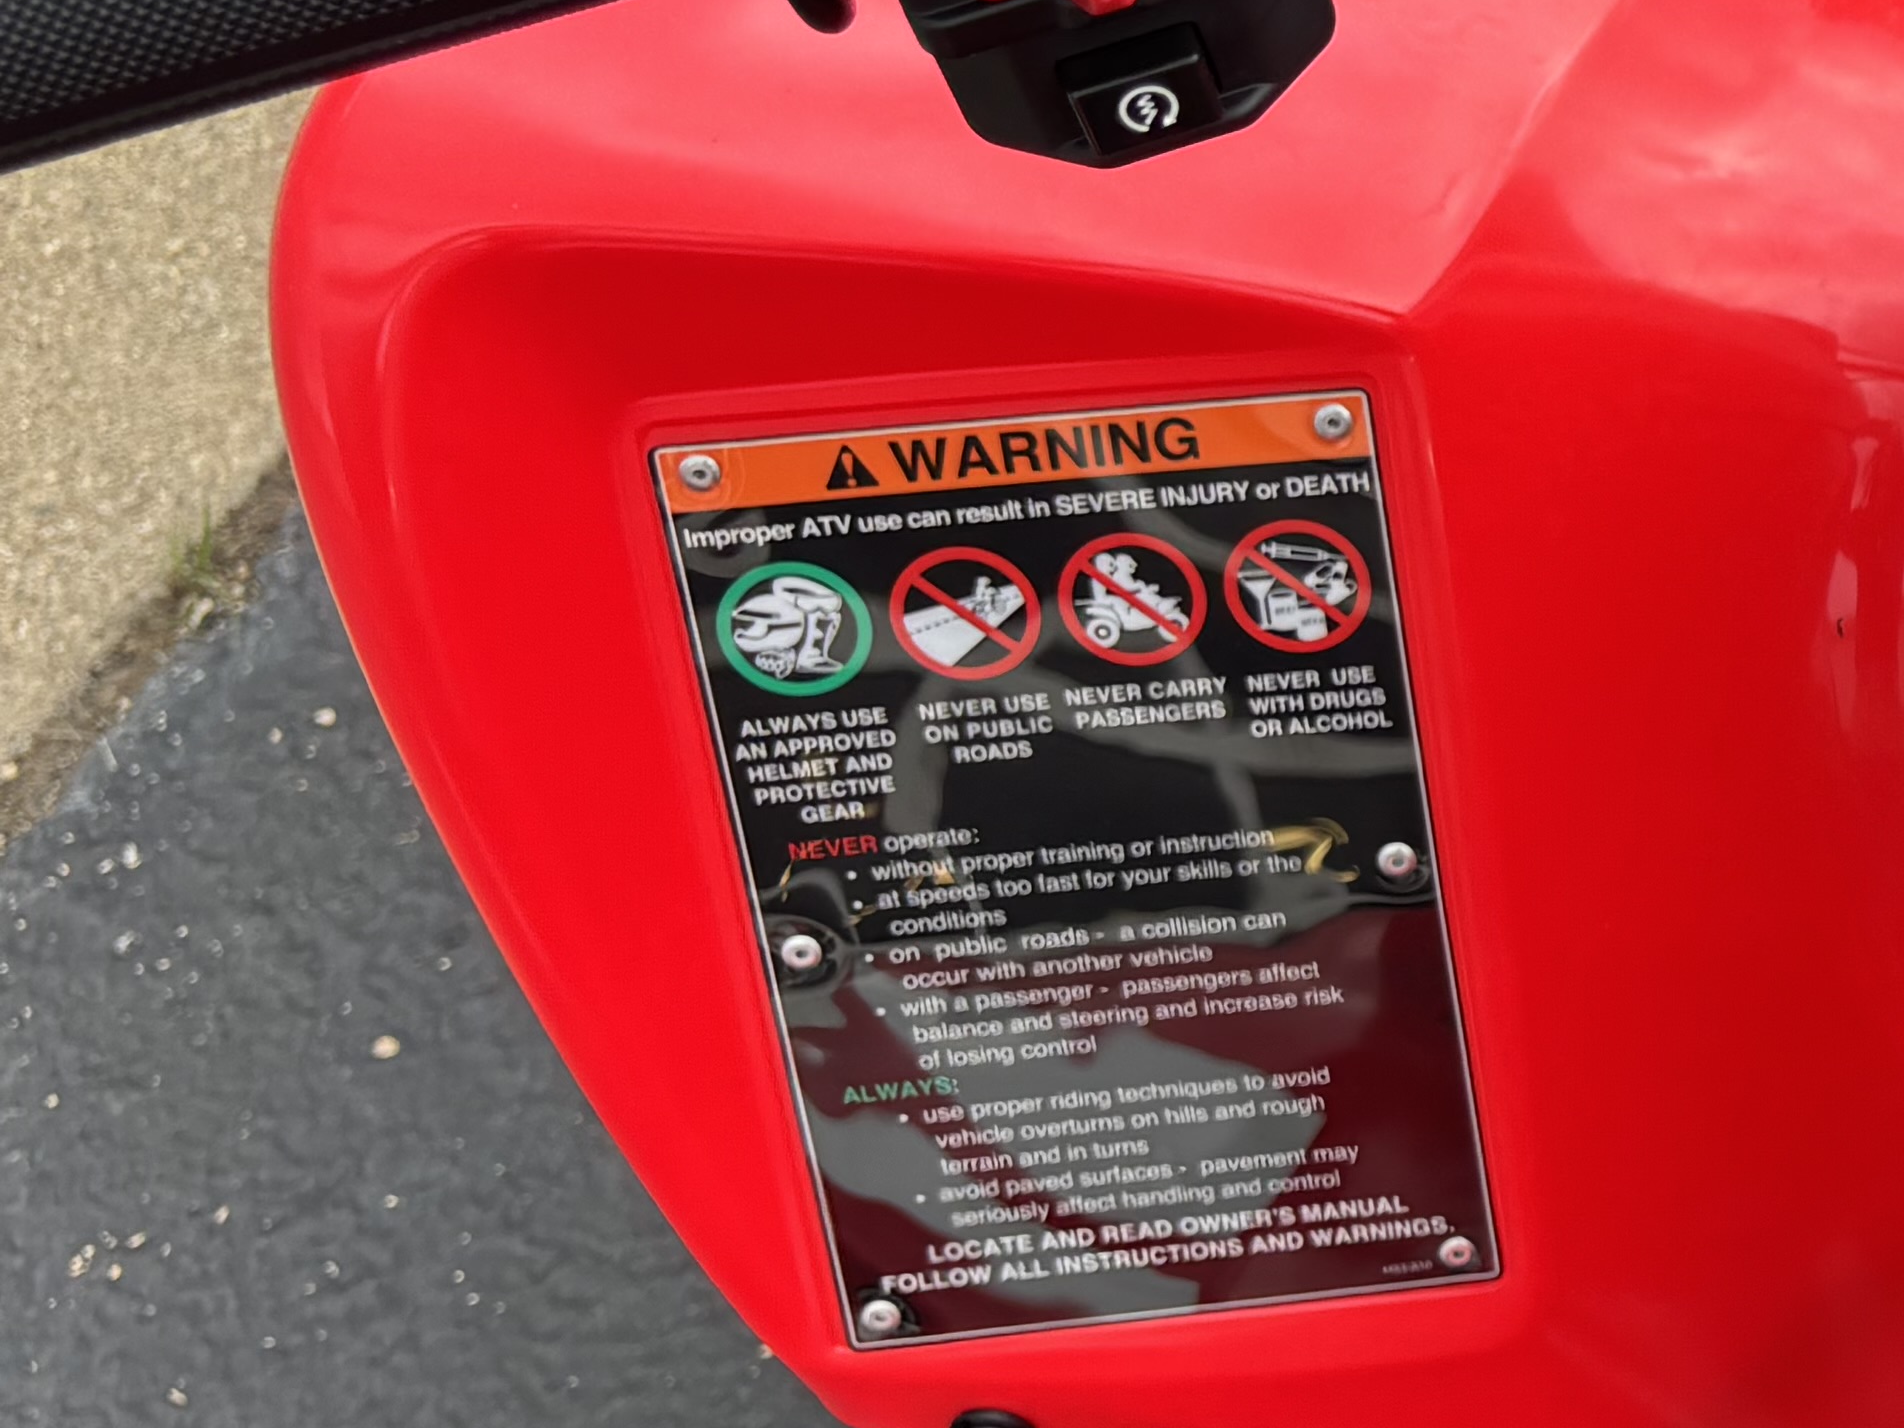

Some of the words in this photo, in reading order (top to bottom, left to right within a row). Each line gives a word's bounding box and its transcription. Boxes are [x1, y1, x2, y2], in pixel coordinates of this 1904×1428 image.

[888, 416, 1200, 483] WARNING
[683, 523, 795, 550] Improper
[801, 513, 851, 538] ATV
[857, 513, 903, 533] use
[906, 509, 951, 529] can
[955, 499, 1024, 524] result
[1027, 497, 1051, 518] in
[1054, 487, 1157, 516] SEVERE
[1159, 480, 1249, 507] INJURY
[1254, 482, 1280, 500] or
[1284, 471, 1370, 497] DEATH
[1064, 683, 1142, 706] NEVER
[1148, 676, 1226, 700] CARRY
[1246, 669, 1320, 692] NEVER
[1330, 665, 1376, 686] USE
[918, 697, 997, 721] NEVER
[1002, 693, 1051, 713] USE
[1074, 699, 1226, 729] PASSENGERS
[1248, 694, 1304, 715] WITH
[1308, 687, 1386, 710] DRUGS
[740, 711, 837, 738] ALWAYS
[841, 706, 888, 727] USE
[923, 724, 959, 744] ON
[965, 715, 1053, 739] PUBLIC
[1249, 718, 1283, 738] OR
[1288, 710, 1393, 735] ALCOHOL
[735, 742, 768, 761] AN
[773, 729, 896, 758] APPROVED
[953, 740, 1033, 763] ROADS
[747, 757, 838, 783] HELMET
[845, 752, 893, 773] AND
[753, 774, 896, 805] PROTECTIVE
[800, 801, 866, 823] GEAR
[788, 834, 878, 861] NEVER
[883, 827, 980, 854] operate:
[871, 854, 956, 882] without
[958, 850, 1034, 877] proper
[1039, 841, 1125, 865] training
[1129, 840, 1154, 858] or
[1159, 828, 1276, 855] instruction
[875, 889, 901, 910] at
[905, 880, 990, 909] speeds
[993, 878, 1032, 897] too
[1035, 872, 1080, 893] fast
[1084, 869, 1115, 889] for
[1120, 866, 1171, 890] your
[1176, 859, 1233, 881] skills
[1237, 859, 1260, 876] or
[1265, 854, 1302, 873] the
[888, 945, 920, 964] on
[932, 933, 1008, 963] public
[1018, 926, 1090, 950] roads
[1119, 925, 1136, 941] a
[1140, 915, 1237, 939] collision
[1240, 912, 1286, 931] can
[889, 909, 1007, 936] conditions
[899, 968, 969, 993] occur
[975, 960, 1026, 982] with
[1032, 953, 1122, 977] another
[1129, 943, 1213, 967] vehicle
[900, 995, 947, 1017] with
[953, 995, 969, 1012] a
[973, 983, 1093, 1014] passenger
[1121, 969, 1253, 999] passengers
[1258, 961, 1320, 984] affect
[911, 1020, 1004, 1043] balance
[1009, 1011, 1053, 1034] and
[1058, 1005, 1149, 1030] steering
[1155, 998, 1198, 1020] and
[1203, 992, 1298, 1015] increase
[1304, 985, 1344, 1006] risk
[918, 1048, 941, 1071] of
[946, 1045, 1015, 1067] losing
[1019, 1034, 1097, 1059] control
[843, 1075, 960, 1104] ALWAYS:
[922, 1100, 966, 1124] use
[964, 1097, 1043, 1123] proper
[1049, 1090, 1112, 1110] riding
[1116, 1078, 1238, 1103] techniques
[1242, 1073, 1271, 1094] to
[1268, 1065, 1331, 1094] avoid
[933, 1124, 1014, 1156] vehicle
[1020, 1115, 1125, 1140] overturns
[1130, 1112, 1159, 1129] on
[1163, 1105, 1209, 1124] hills
[1214, 1099, 1256, 1120] and
[1261, 1093, 1325, 1118] rough
[936, 1149, 1015, 1176] terrain
[1013, 1145, 1061, 1168] and
[1067, 1146, 1087, 1161] in
[1092, 1140, 1149, 1158] turns
[940, 1177, 1000, 1202] avoid
[1004, 1171, 1074, 1199] paved
[1079, 1163, 1173, 1187] surfaces
[1199, 1144, 1307, 1177] pavement
[1312, 1145, 1358, 1164] may
[951, 1200, 1050, 1227] seriously
[1052, 1193, 1117, 1217] affect
[1121, 1185, 1215, 1207] handling
[1221, 1177, 1267, 1199] and
[1265, 1168, 1341, 1199] control
[927, 1234, 1033, 1264] LOCATE
[1041, 1227, 1096, 1250] AND
[1100, 1219, 1173, 1244] READ
[1176, 1206, 1296, 1236] OWNER'S
[1300, 1195, 1409, 1223] MANUAL
[880, 1264, 992, 1295] FOLLOW
[1000, 1259, 1049, 1281] ALL
[1055, 1236, 1244, 1274] INSTRUCTIONS
[1250, 1231, 1304, 1254] AND
